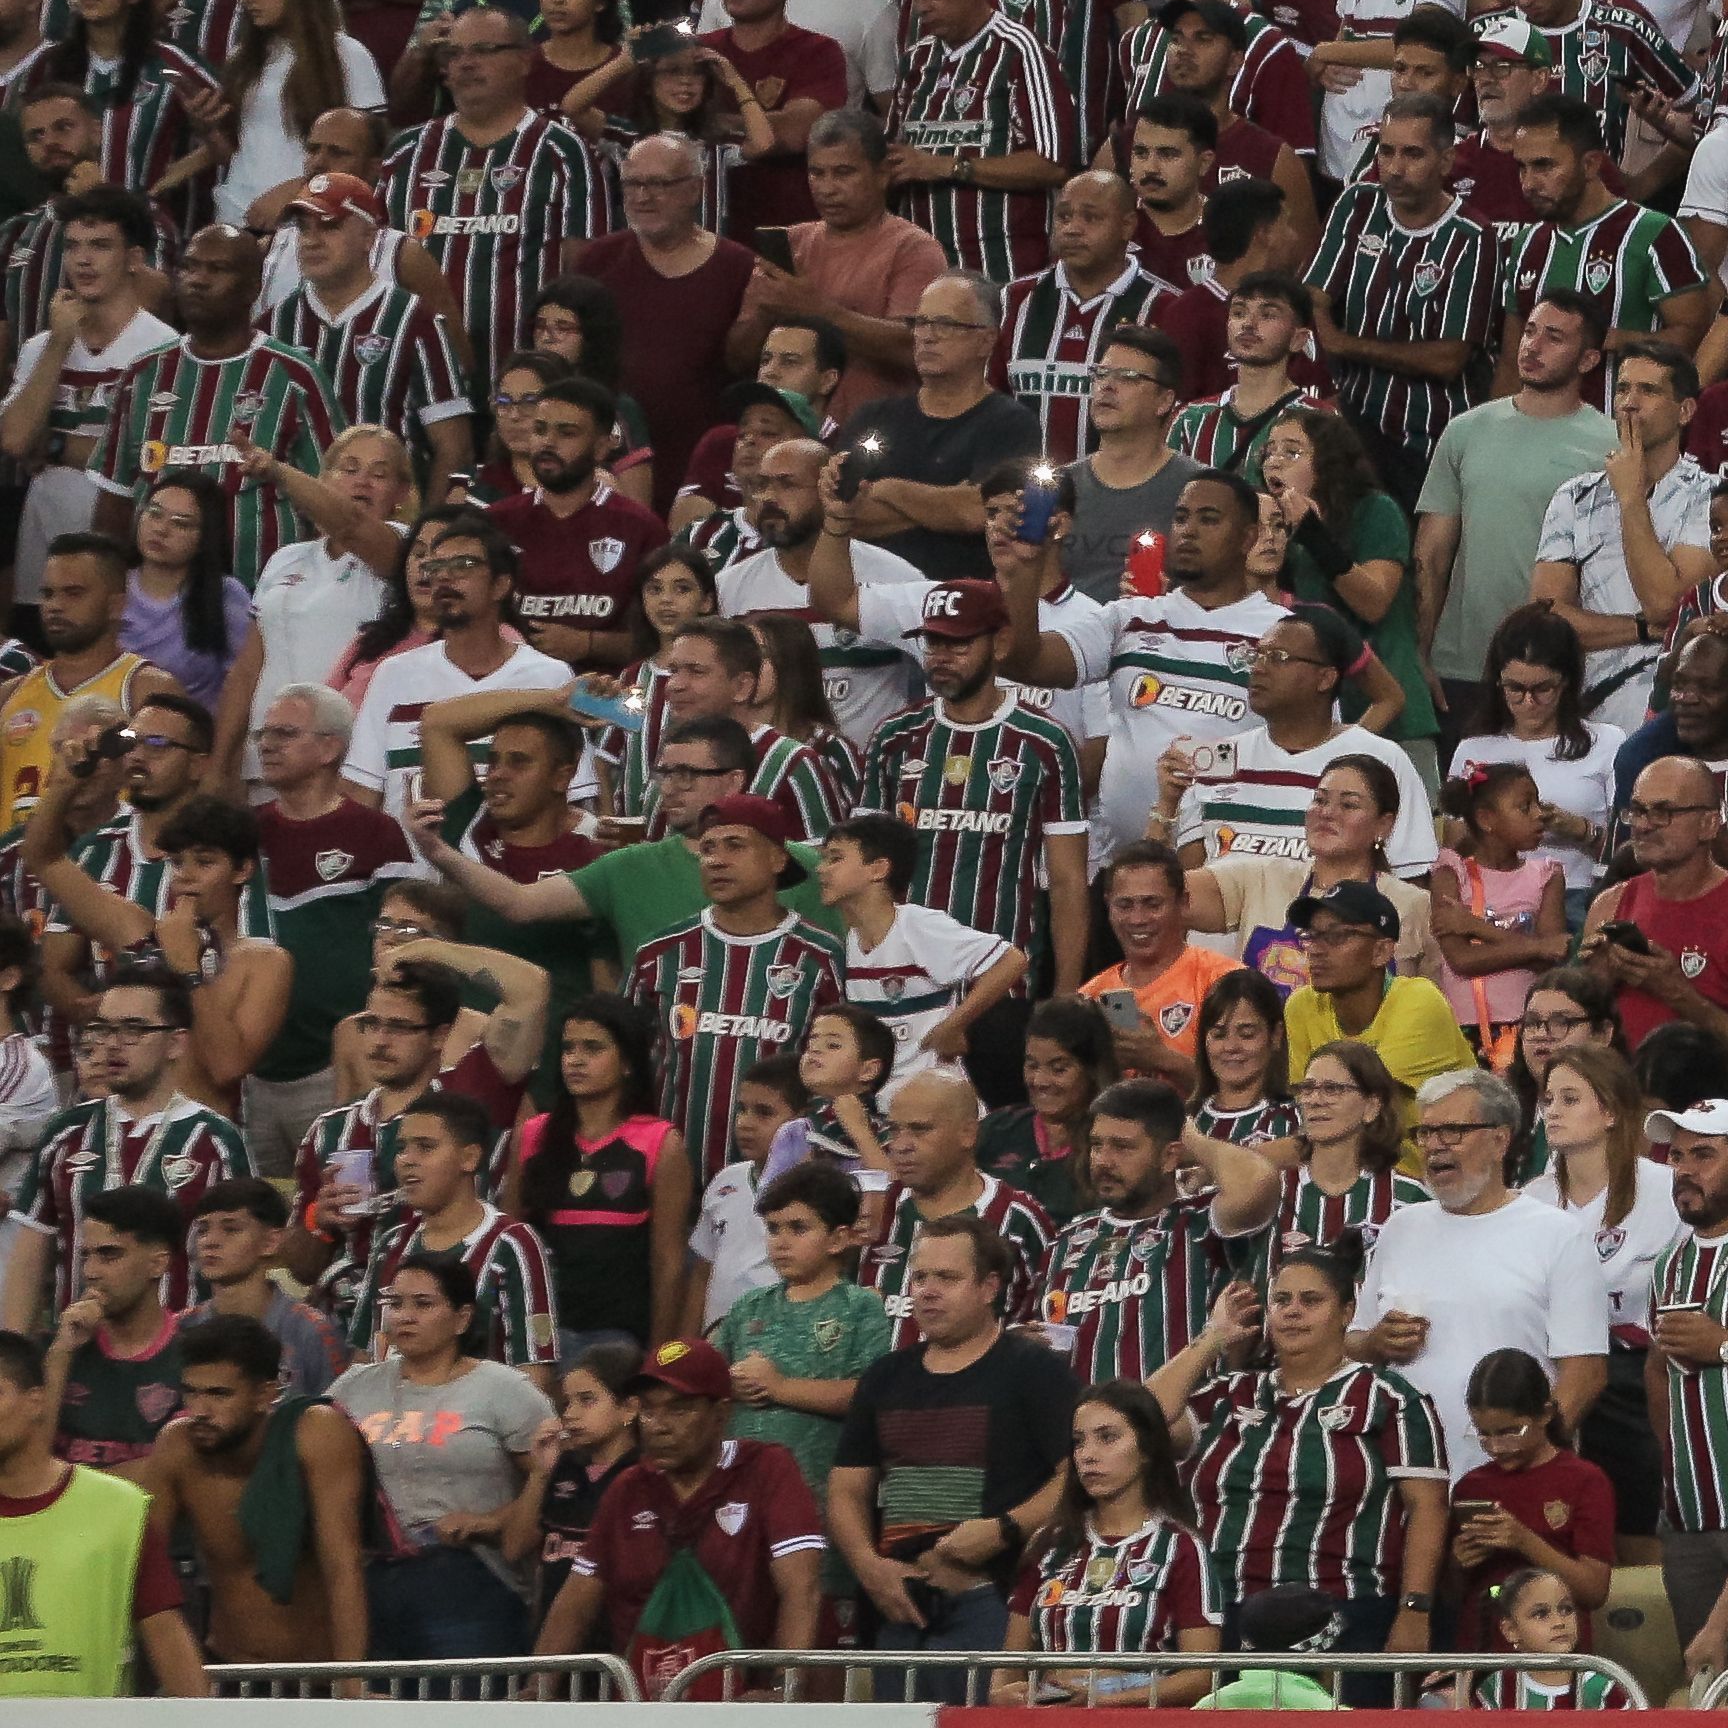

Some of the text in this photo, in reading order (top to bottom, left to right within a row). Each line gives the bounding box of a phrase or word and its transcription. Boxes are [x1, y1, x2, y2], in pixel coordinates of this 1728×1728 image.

[1594, 7, 1666, 50] ZINZANE
[433, 215, 519, 235] BETANO
[168, 444, 244, 465] BETAN
[522, 593, 614, 618] BETANO
[1158, 683, 1247, 721] BETANO
[917, 808, 1012, 833] BETANO
[1230, 832, 1312, 861] BETAN
[699, 1011, 793, 1043] BETANO
[1067, 1273, 1150, 1315] BEANO
[358, 1410, 463, 1446] GAP
